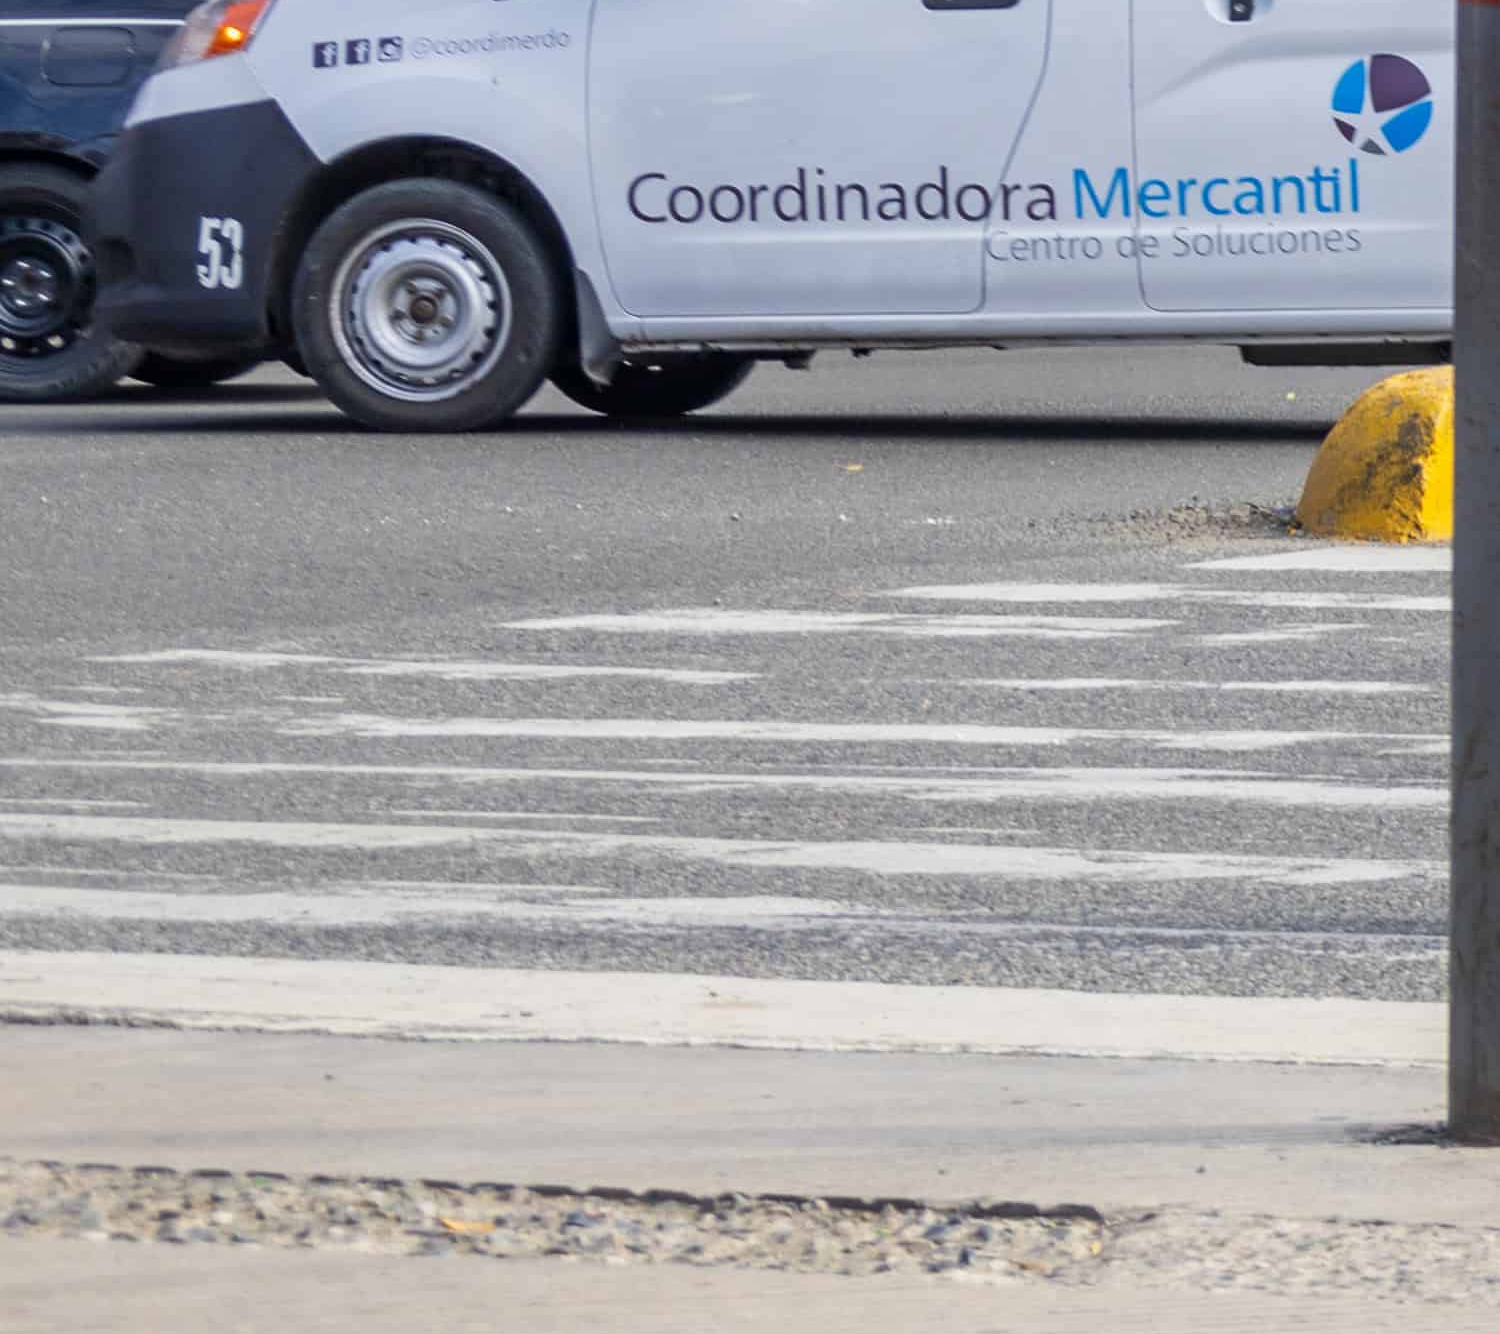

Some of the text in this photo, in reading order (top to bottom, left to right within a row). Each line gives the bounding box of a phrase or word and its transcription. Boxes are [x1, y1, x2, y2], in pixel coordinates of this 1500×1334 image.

[627, 157, 1361, 224] Coordinadora Mercantil
[196, 215, 244, 289] 53
[985, 223, 1363, 262] Centro de Soluciones
